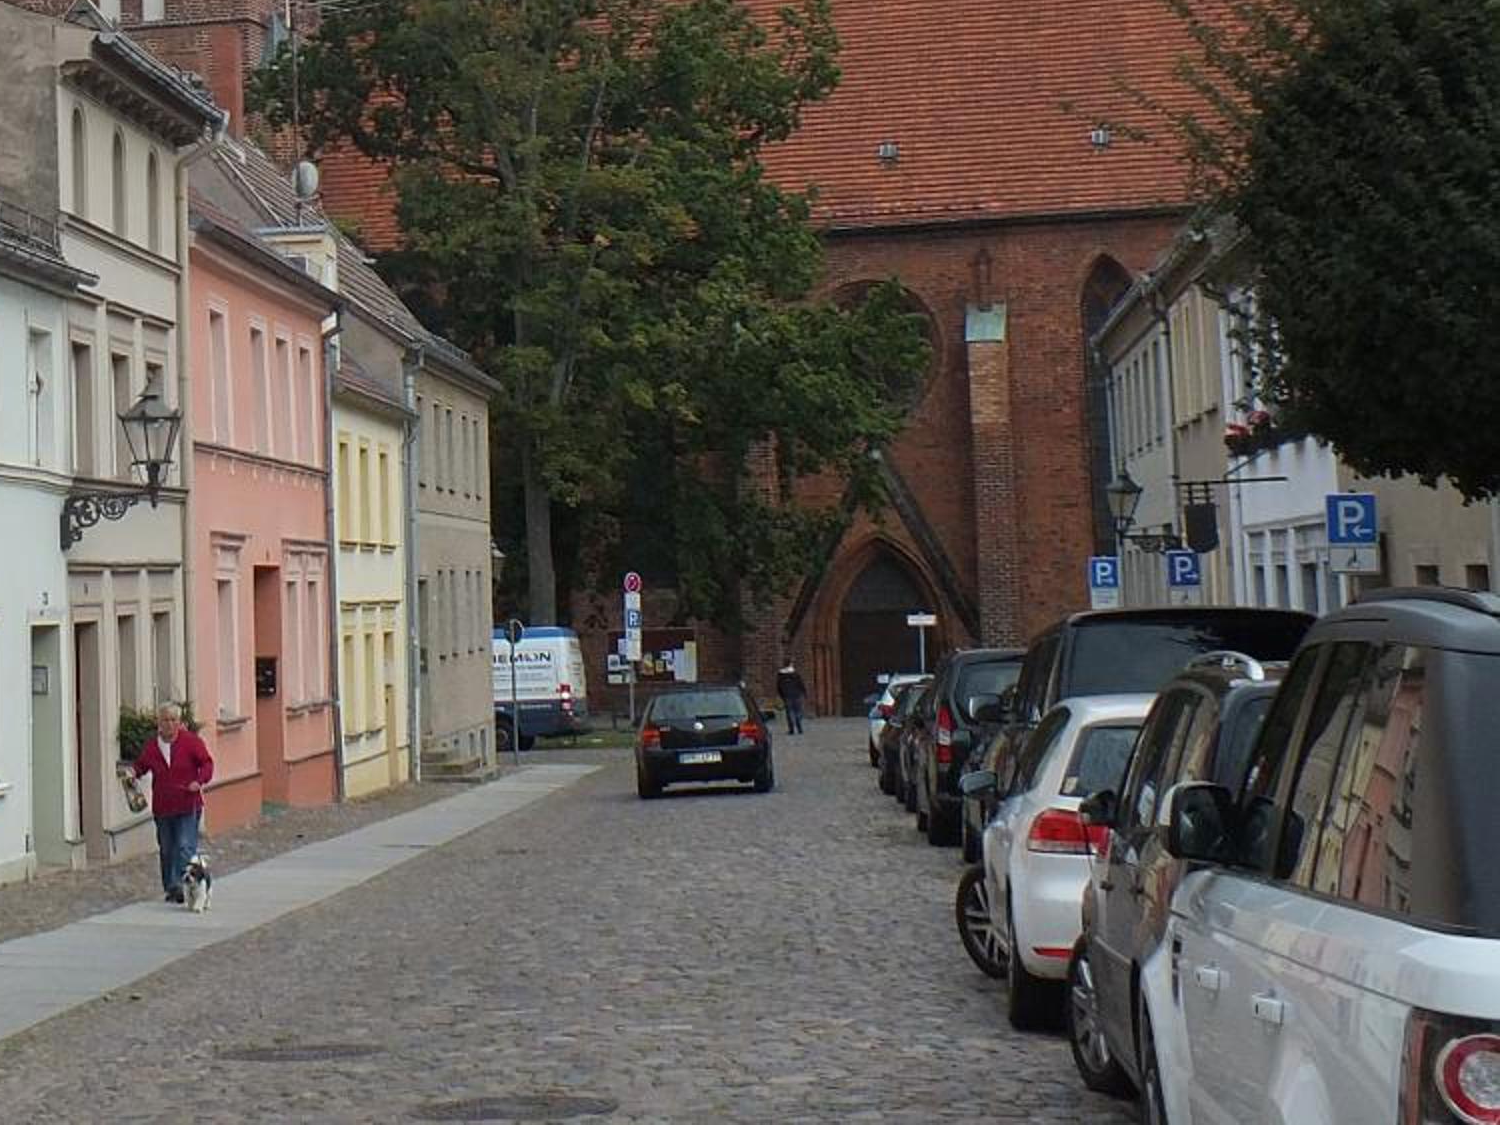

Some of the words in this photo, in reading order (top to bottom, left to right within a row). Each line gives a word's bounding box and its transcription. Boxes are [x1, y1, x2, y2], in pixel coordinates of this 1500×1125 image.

[1337, 500, 1365, 538] P
[1095, 562, 1112, 585] P
[1174, 556, 1193, 582] P
